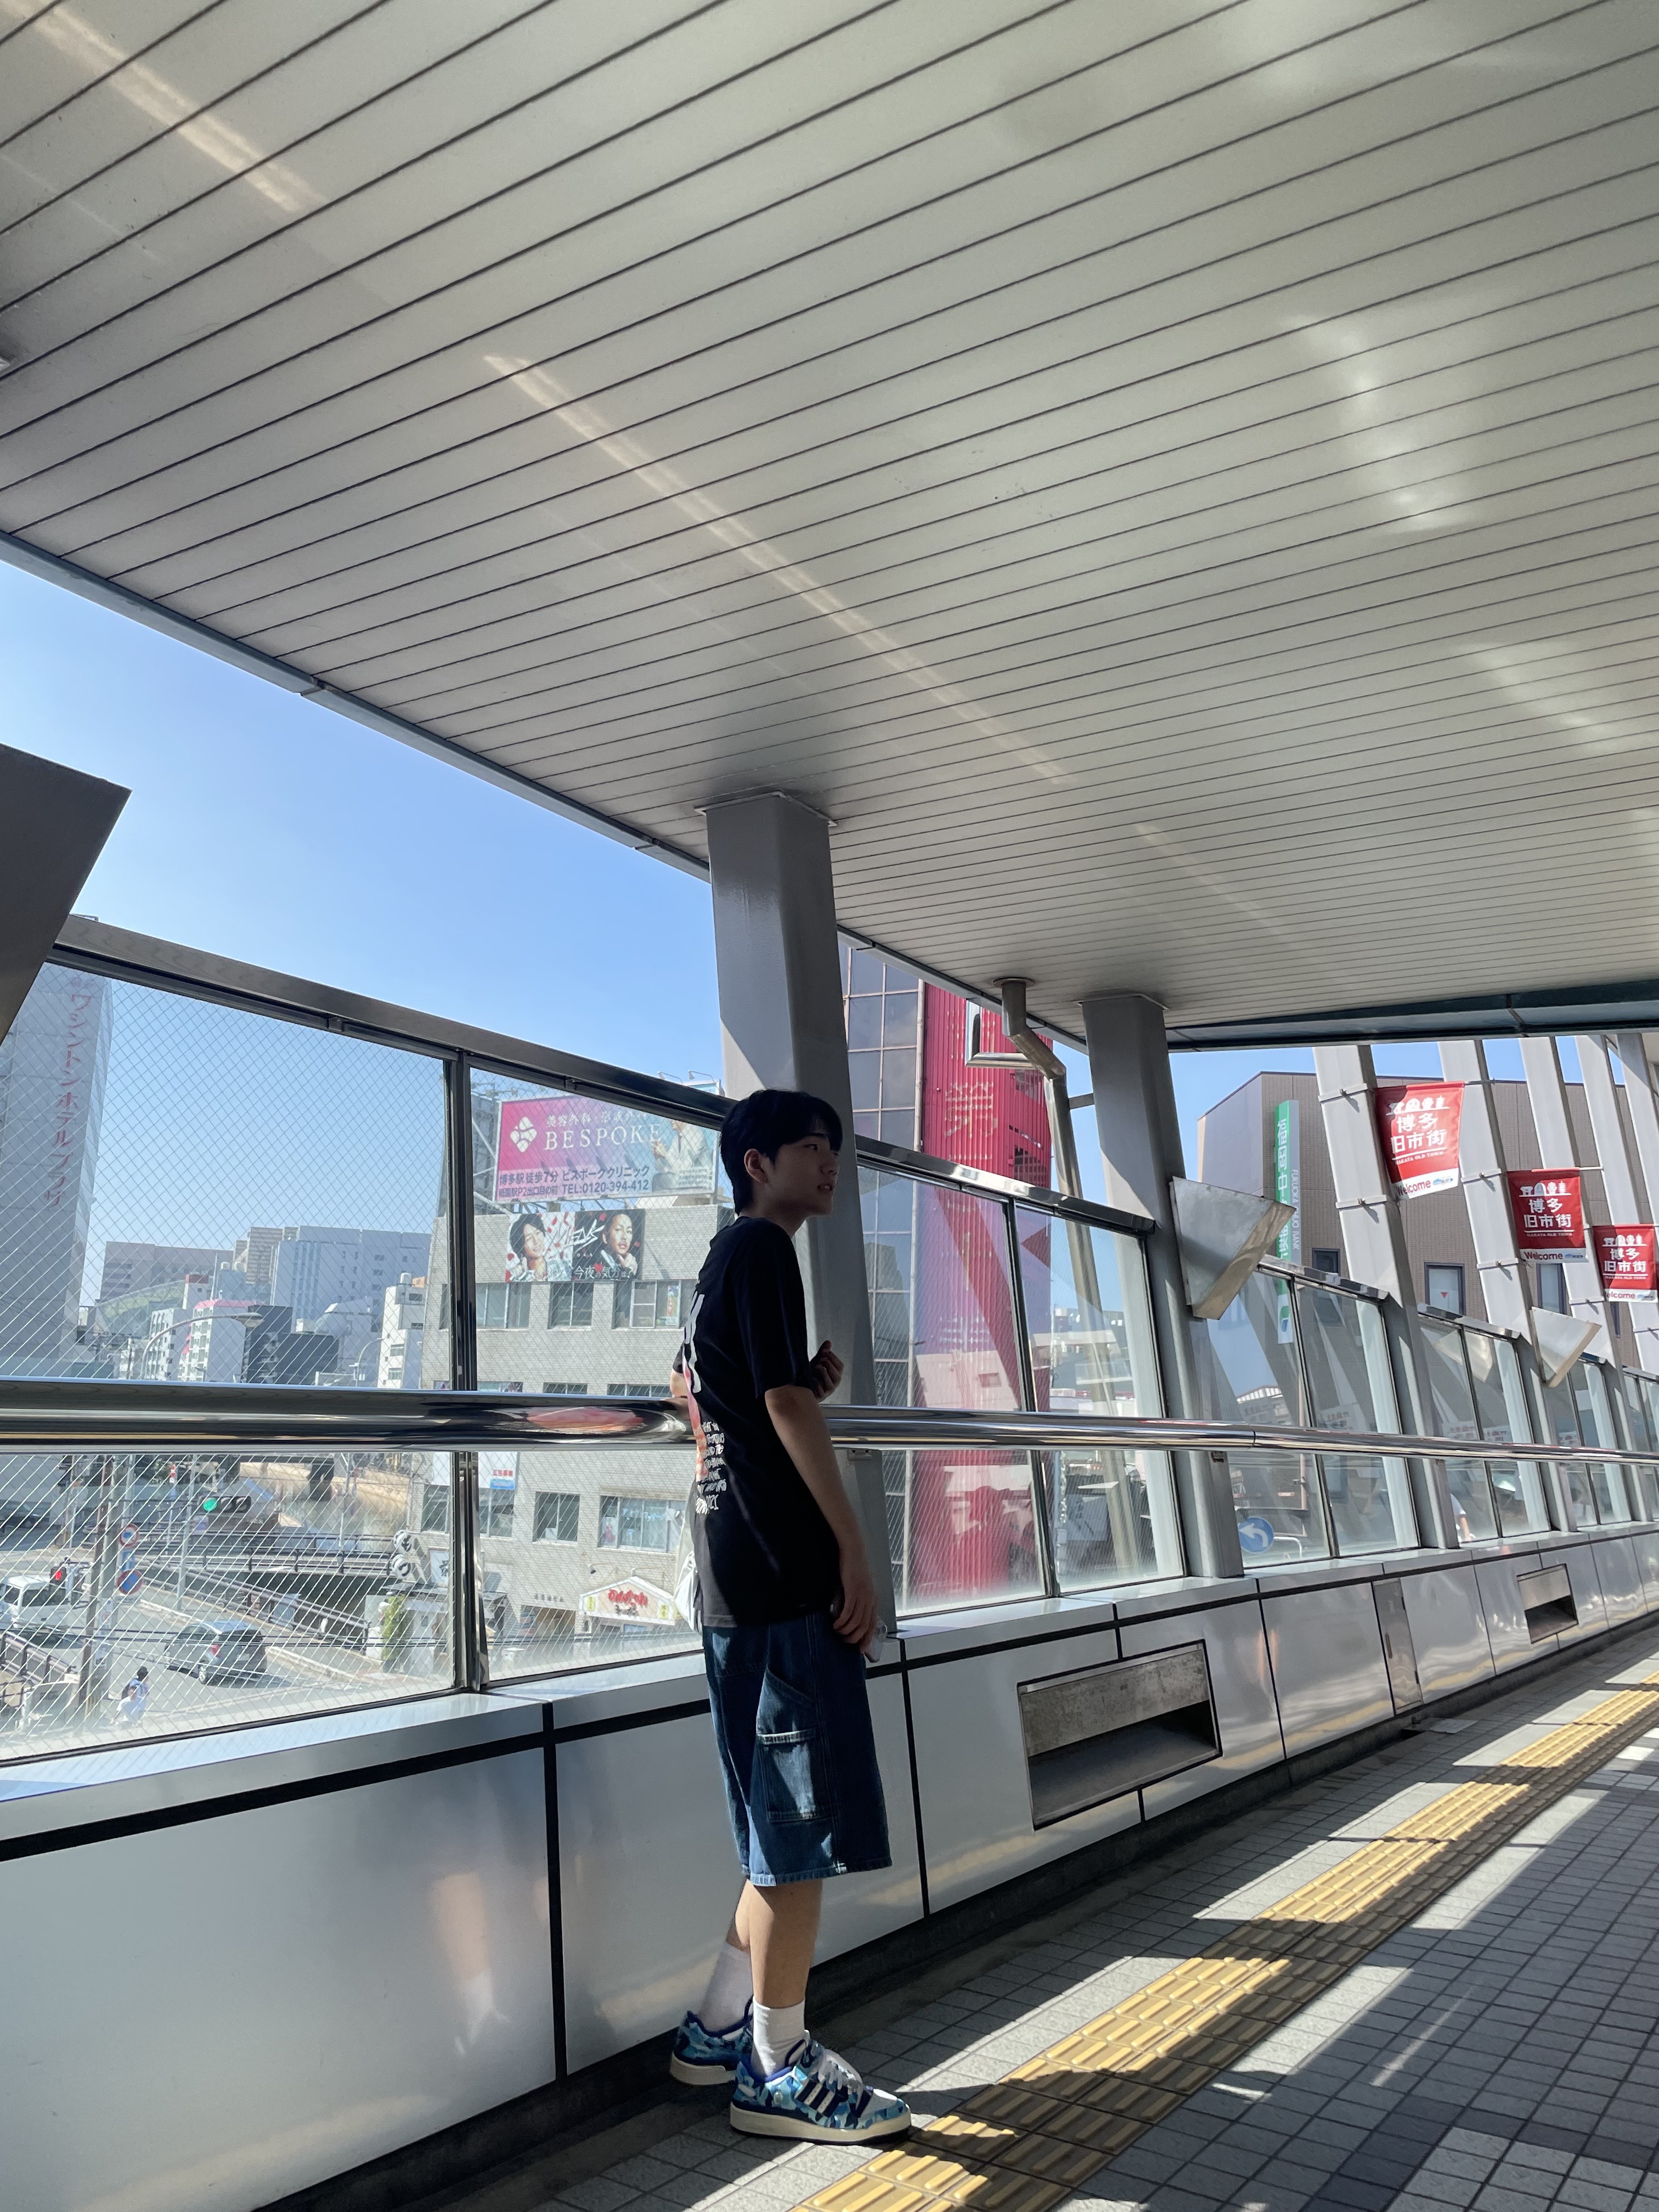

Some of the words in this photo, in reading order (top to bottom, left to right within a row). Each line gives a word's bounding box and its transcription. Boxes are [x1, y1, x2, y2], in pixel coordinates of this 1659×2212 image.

[45, 994, 92, 1206] ワシントンホテルプラザ
[1397, 1113, 1438, 1134] 博多
[544, 1124, 662, 1150] BESPOKE
[1390, 1129, 1448, 1154] 旧市街
[562, 1164, 650, 1182] ビスポーククリニック
[562, 1179, 649, 1195] TEL:0120-394-412
[1291, 1169, 1299, 1204] FUKUOKA
[1395, 1179, 1431, 1196] Welcome
[1528, 1198, 1563, 1214] 博多
[1523, 1214, 1572, 1228] 旧市街
[1523, 1251, 1563, 1260] Welcome
[1610, 1248, 1640, 1260] 博多
[1604, 1260, 1646, 1273] 旧市街
[1606, 1291, 1635, 1299] elcome
